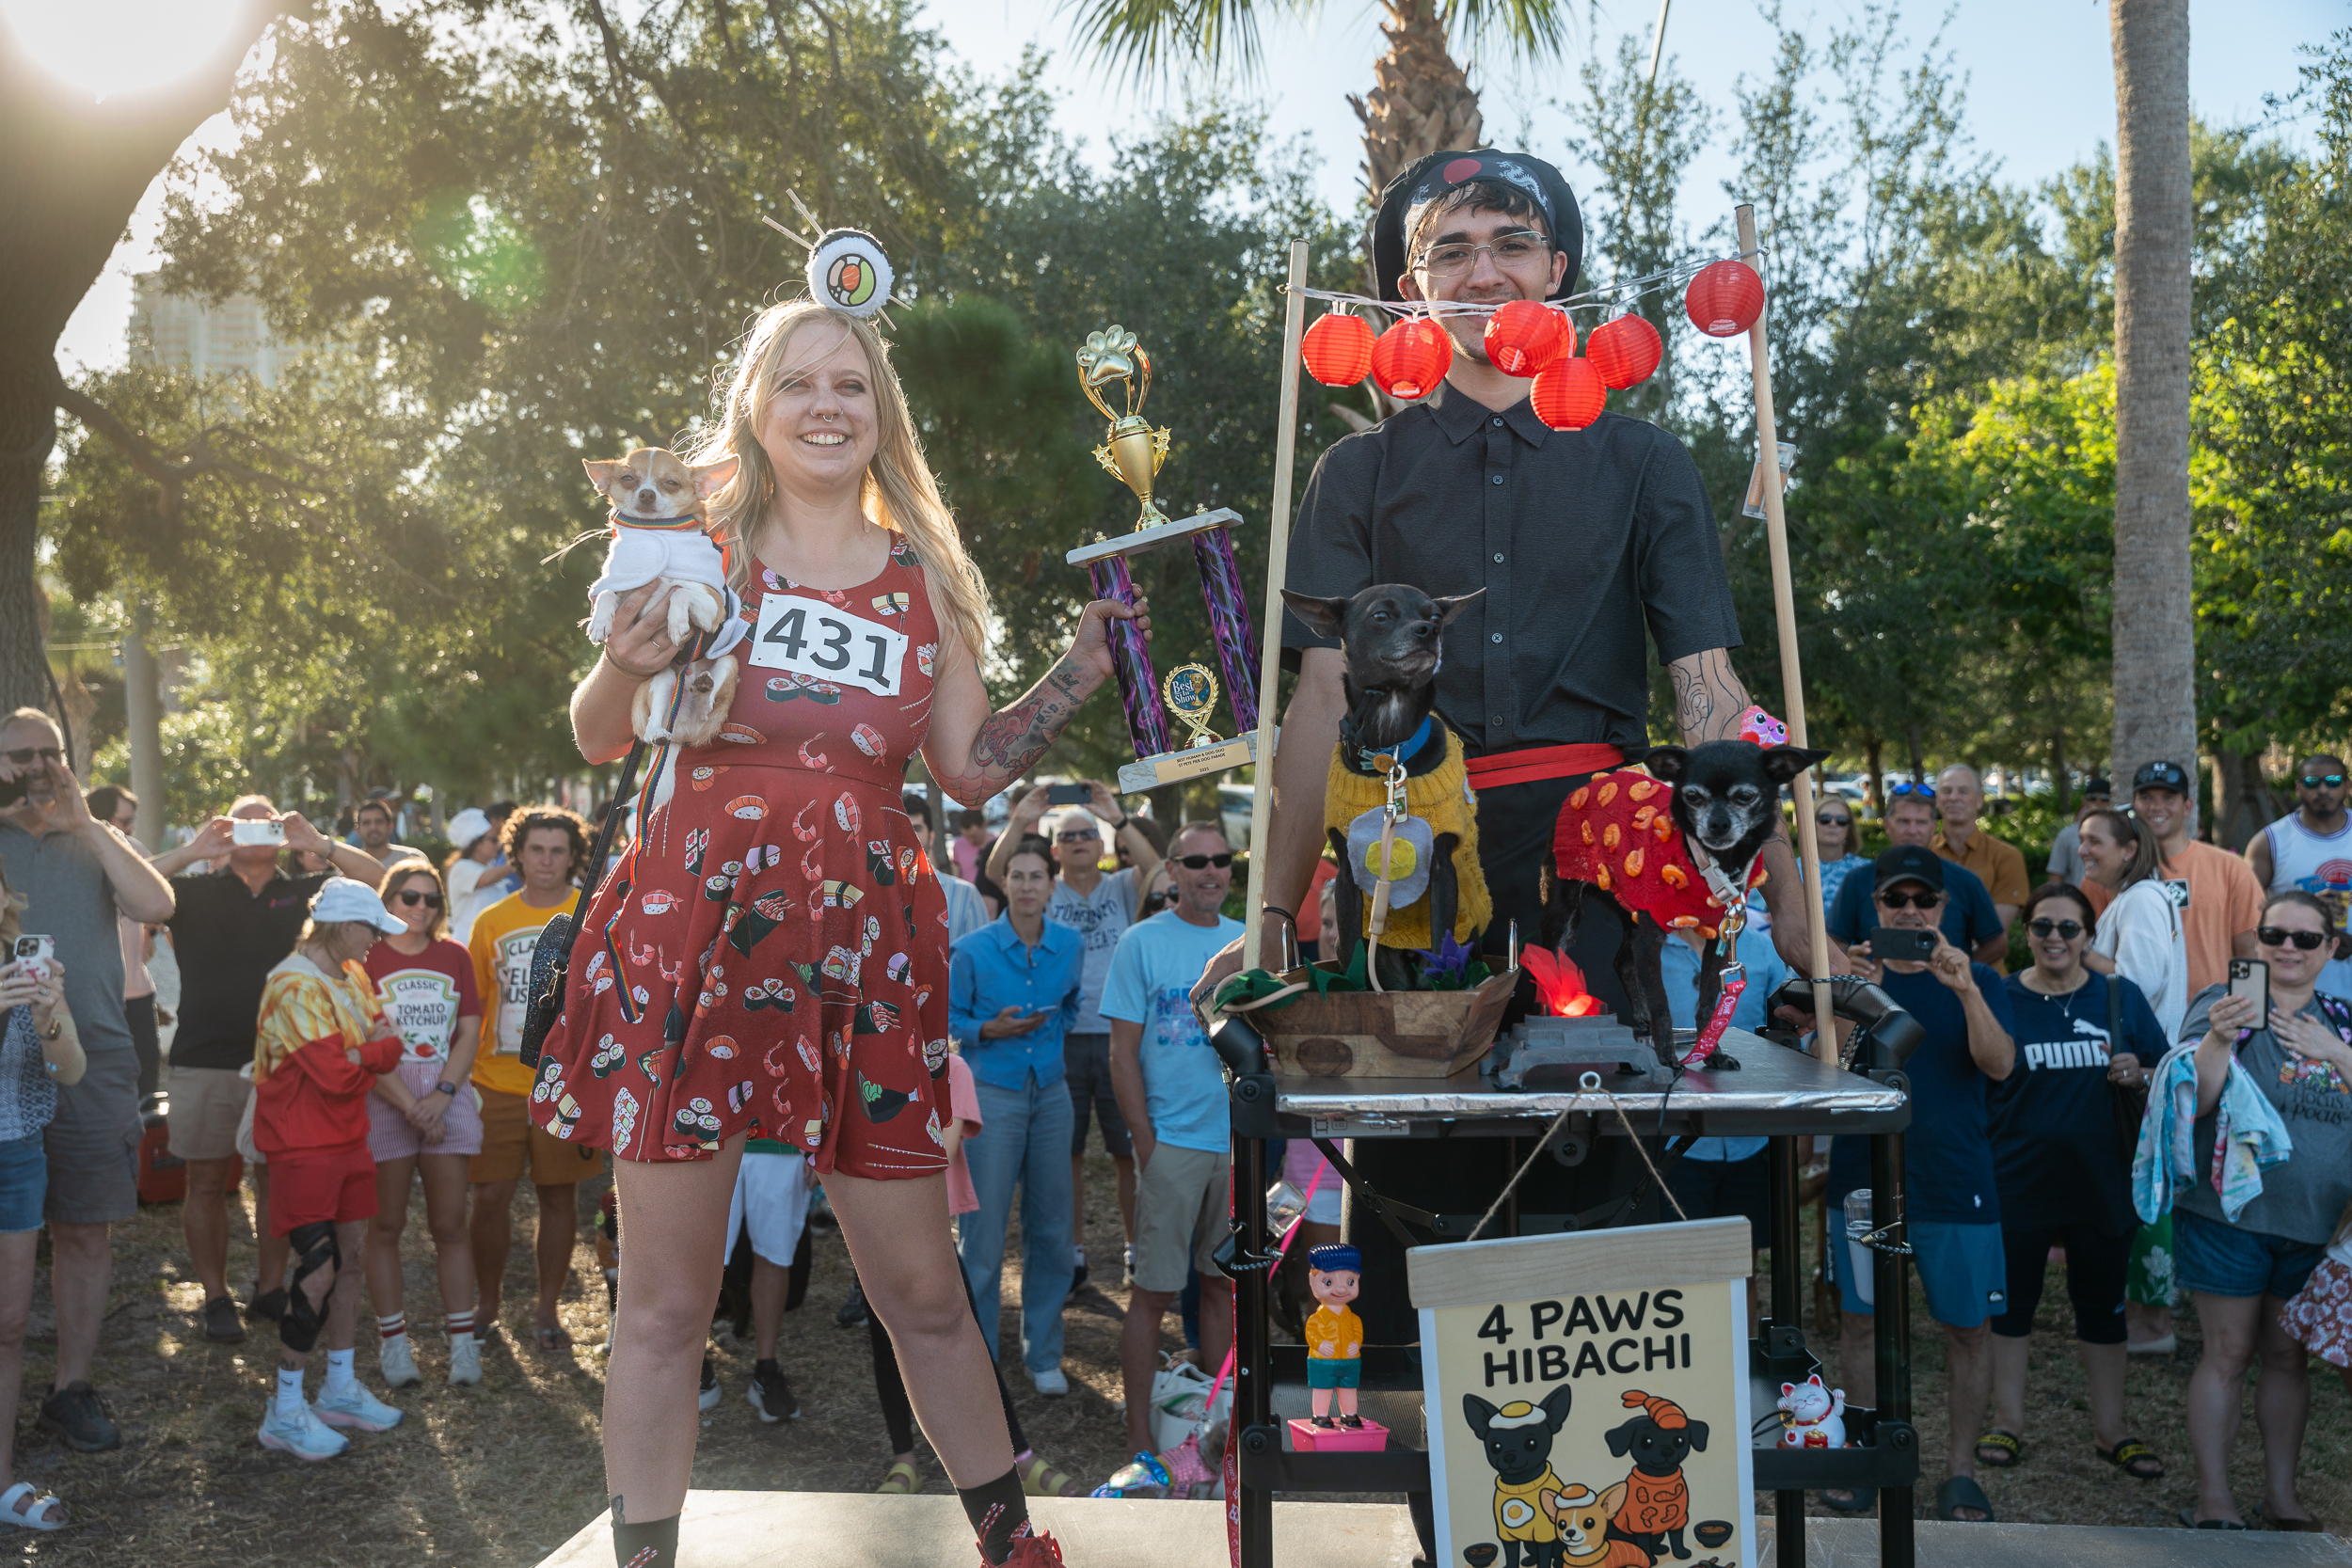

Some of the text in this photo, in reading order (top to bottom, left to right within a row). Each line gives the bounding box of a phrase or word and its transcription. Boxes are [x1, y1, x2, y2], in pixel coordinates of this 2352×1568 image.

[762, 608, 891, 689] 431
[1057, 673, 1080, 687] Still
[1172, 679, 1195, 695] Best
[1175, 693, 1196, 705] Show
[397, 979, 439, 992] CLASSIC
[397, 1003, 445, 1015] TOMATO
[396, 1014, 447, 1026] KETCHUP
[2024, 1039, 2110, 1071] PUMA
[1477, 1289, 1684, 1344] 4 PAWS
[1484, 1333, 1691, 1387] HIBACHI
